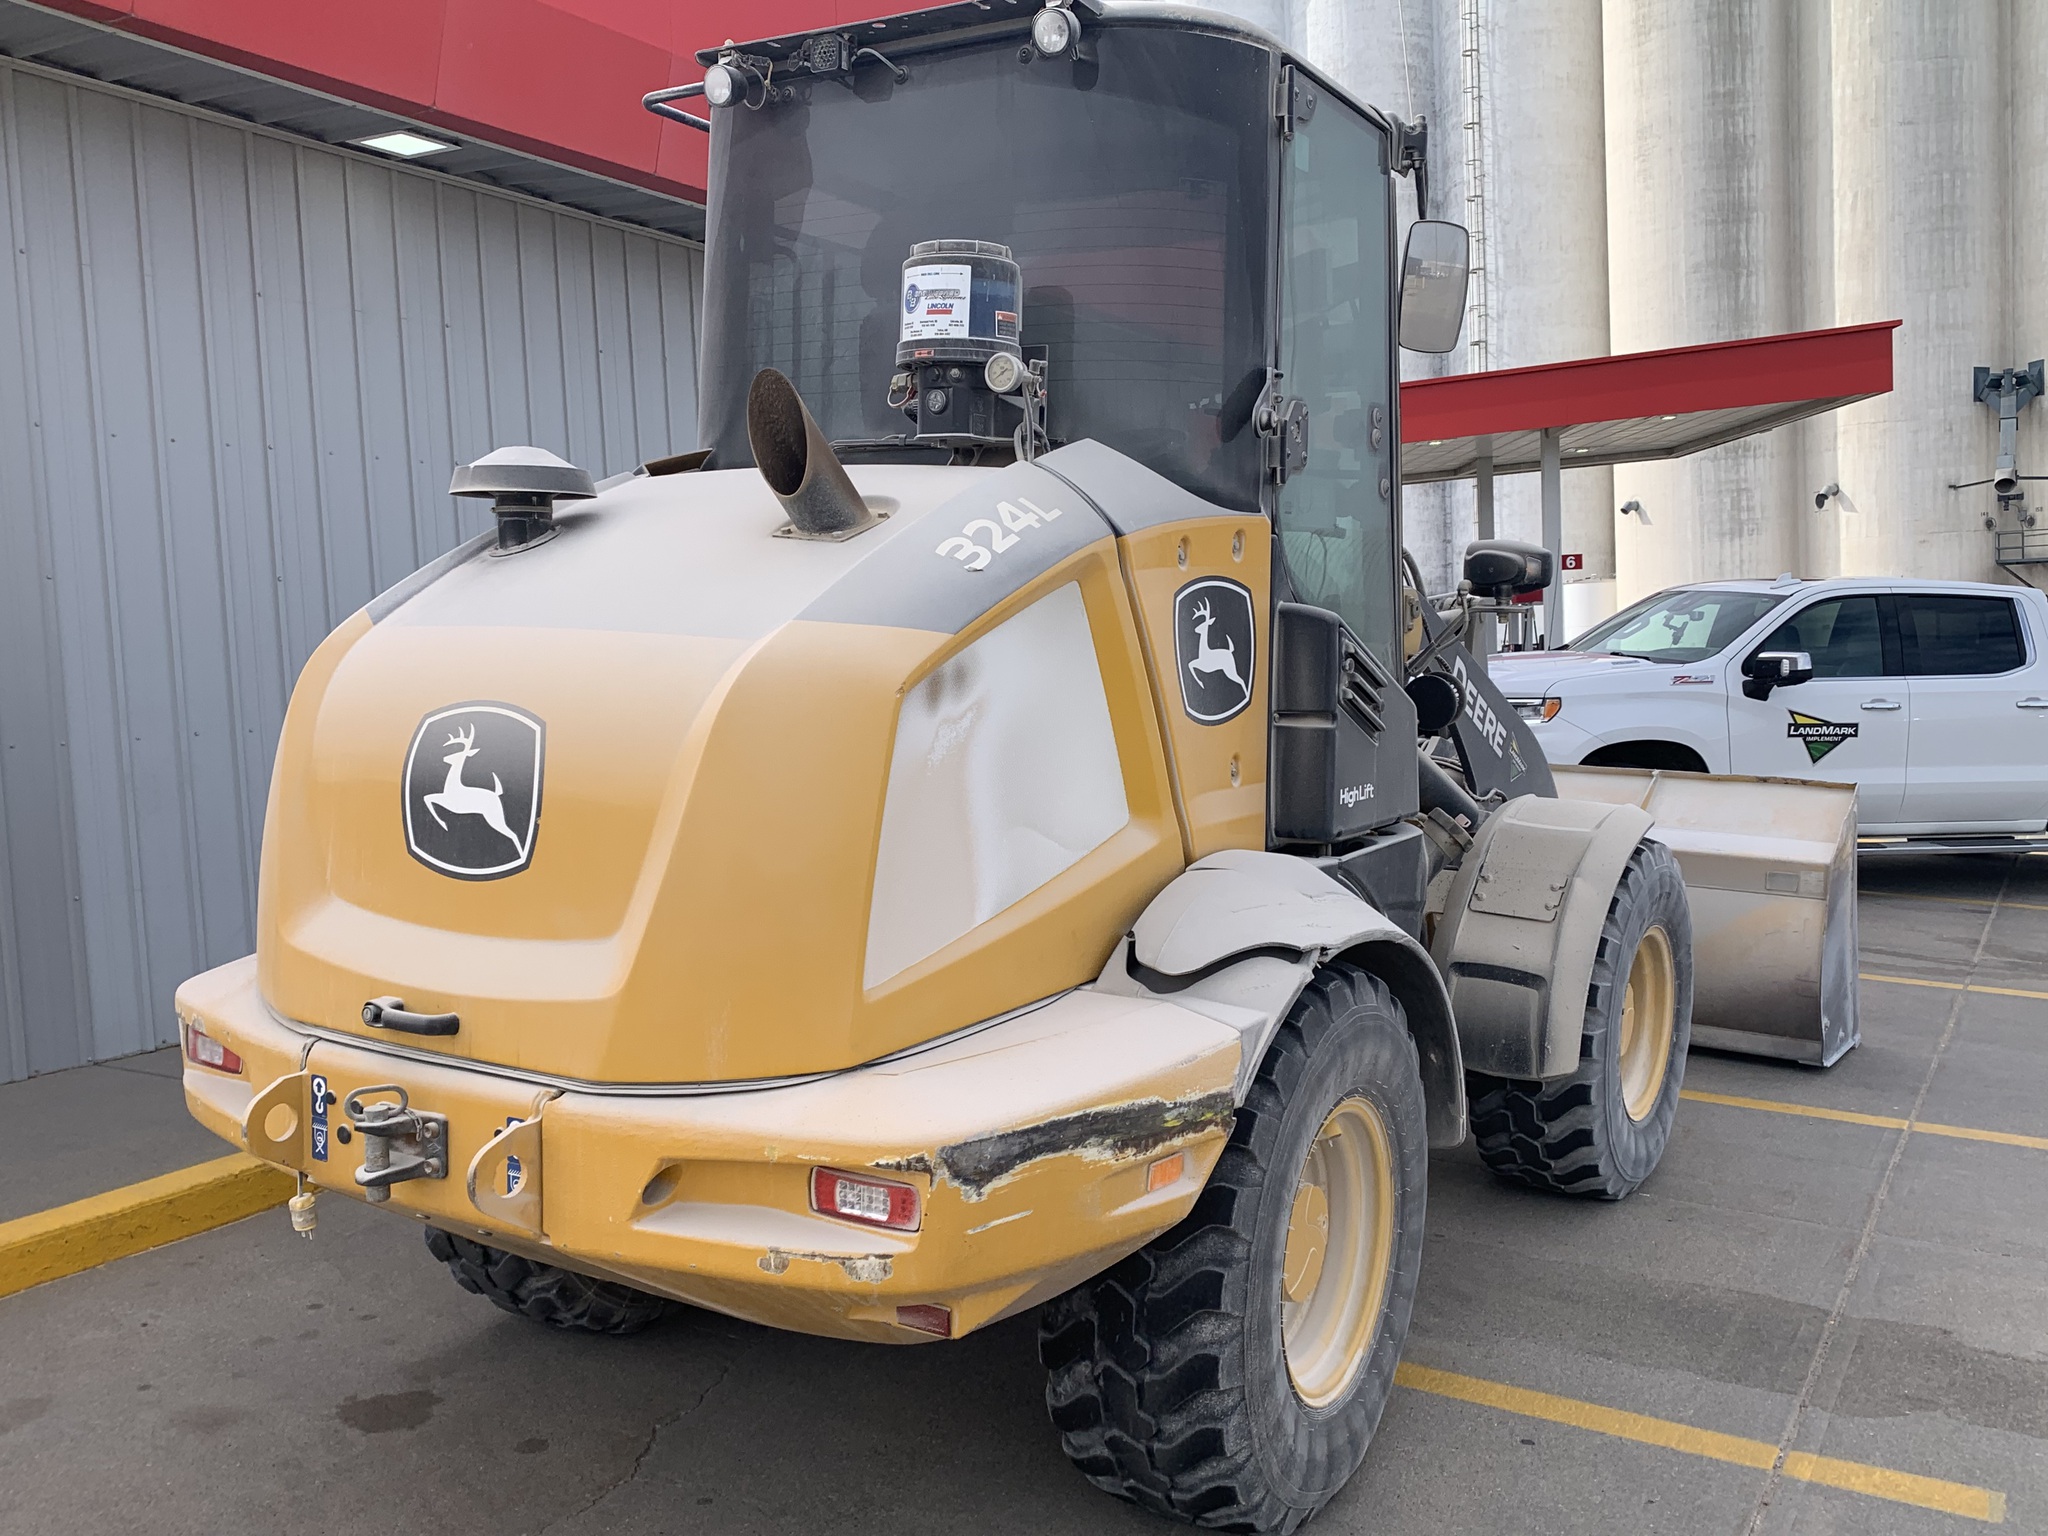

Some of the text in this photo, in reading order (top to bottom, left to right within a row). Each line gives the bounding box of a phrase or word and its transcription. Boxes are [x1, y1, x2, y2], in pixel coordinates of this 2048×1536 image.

[927, 302, 954, 310] LINCOLN
[935, 497, 1063, 572] 324L
[1566, 556, 1576, 569] 6
[1453, 655, 1507, 759] DEERE
